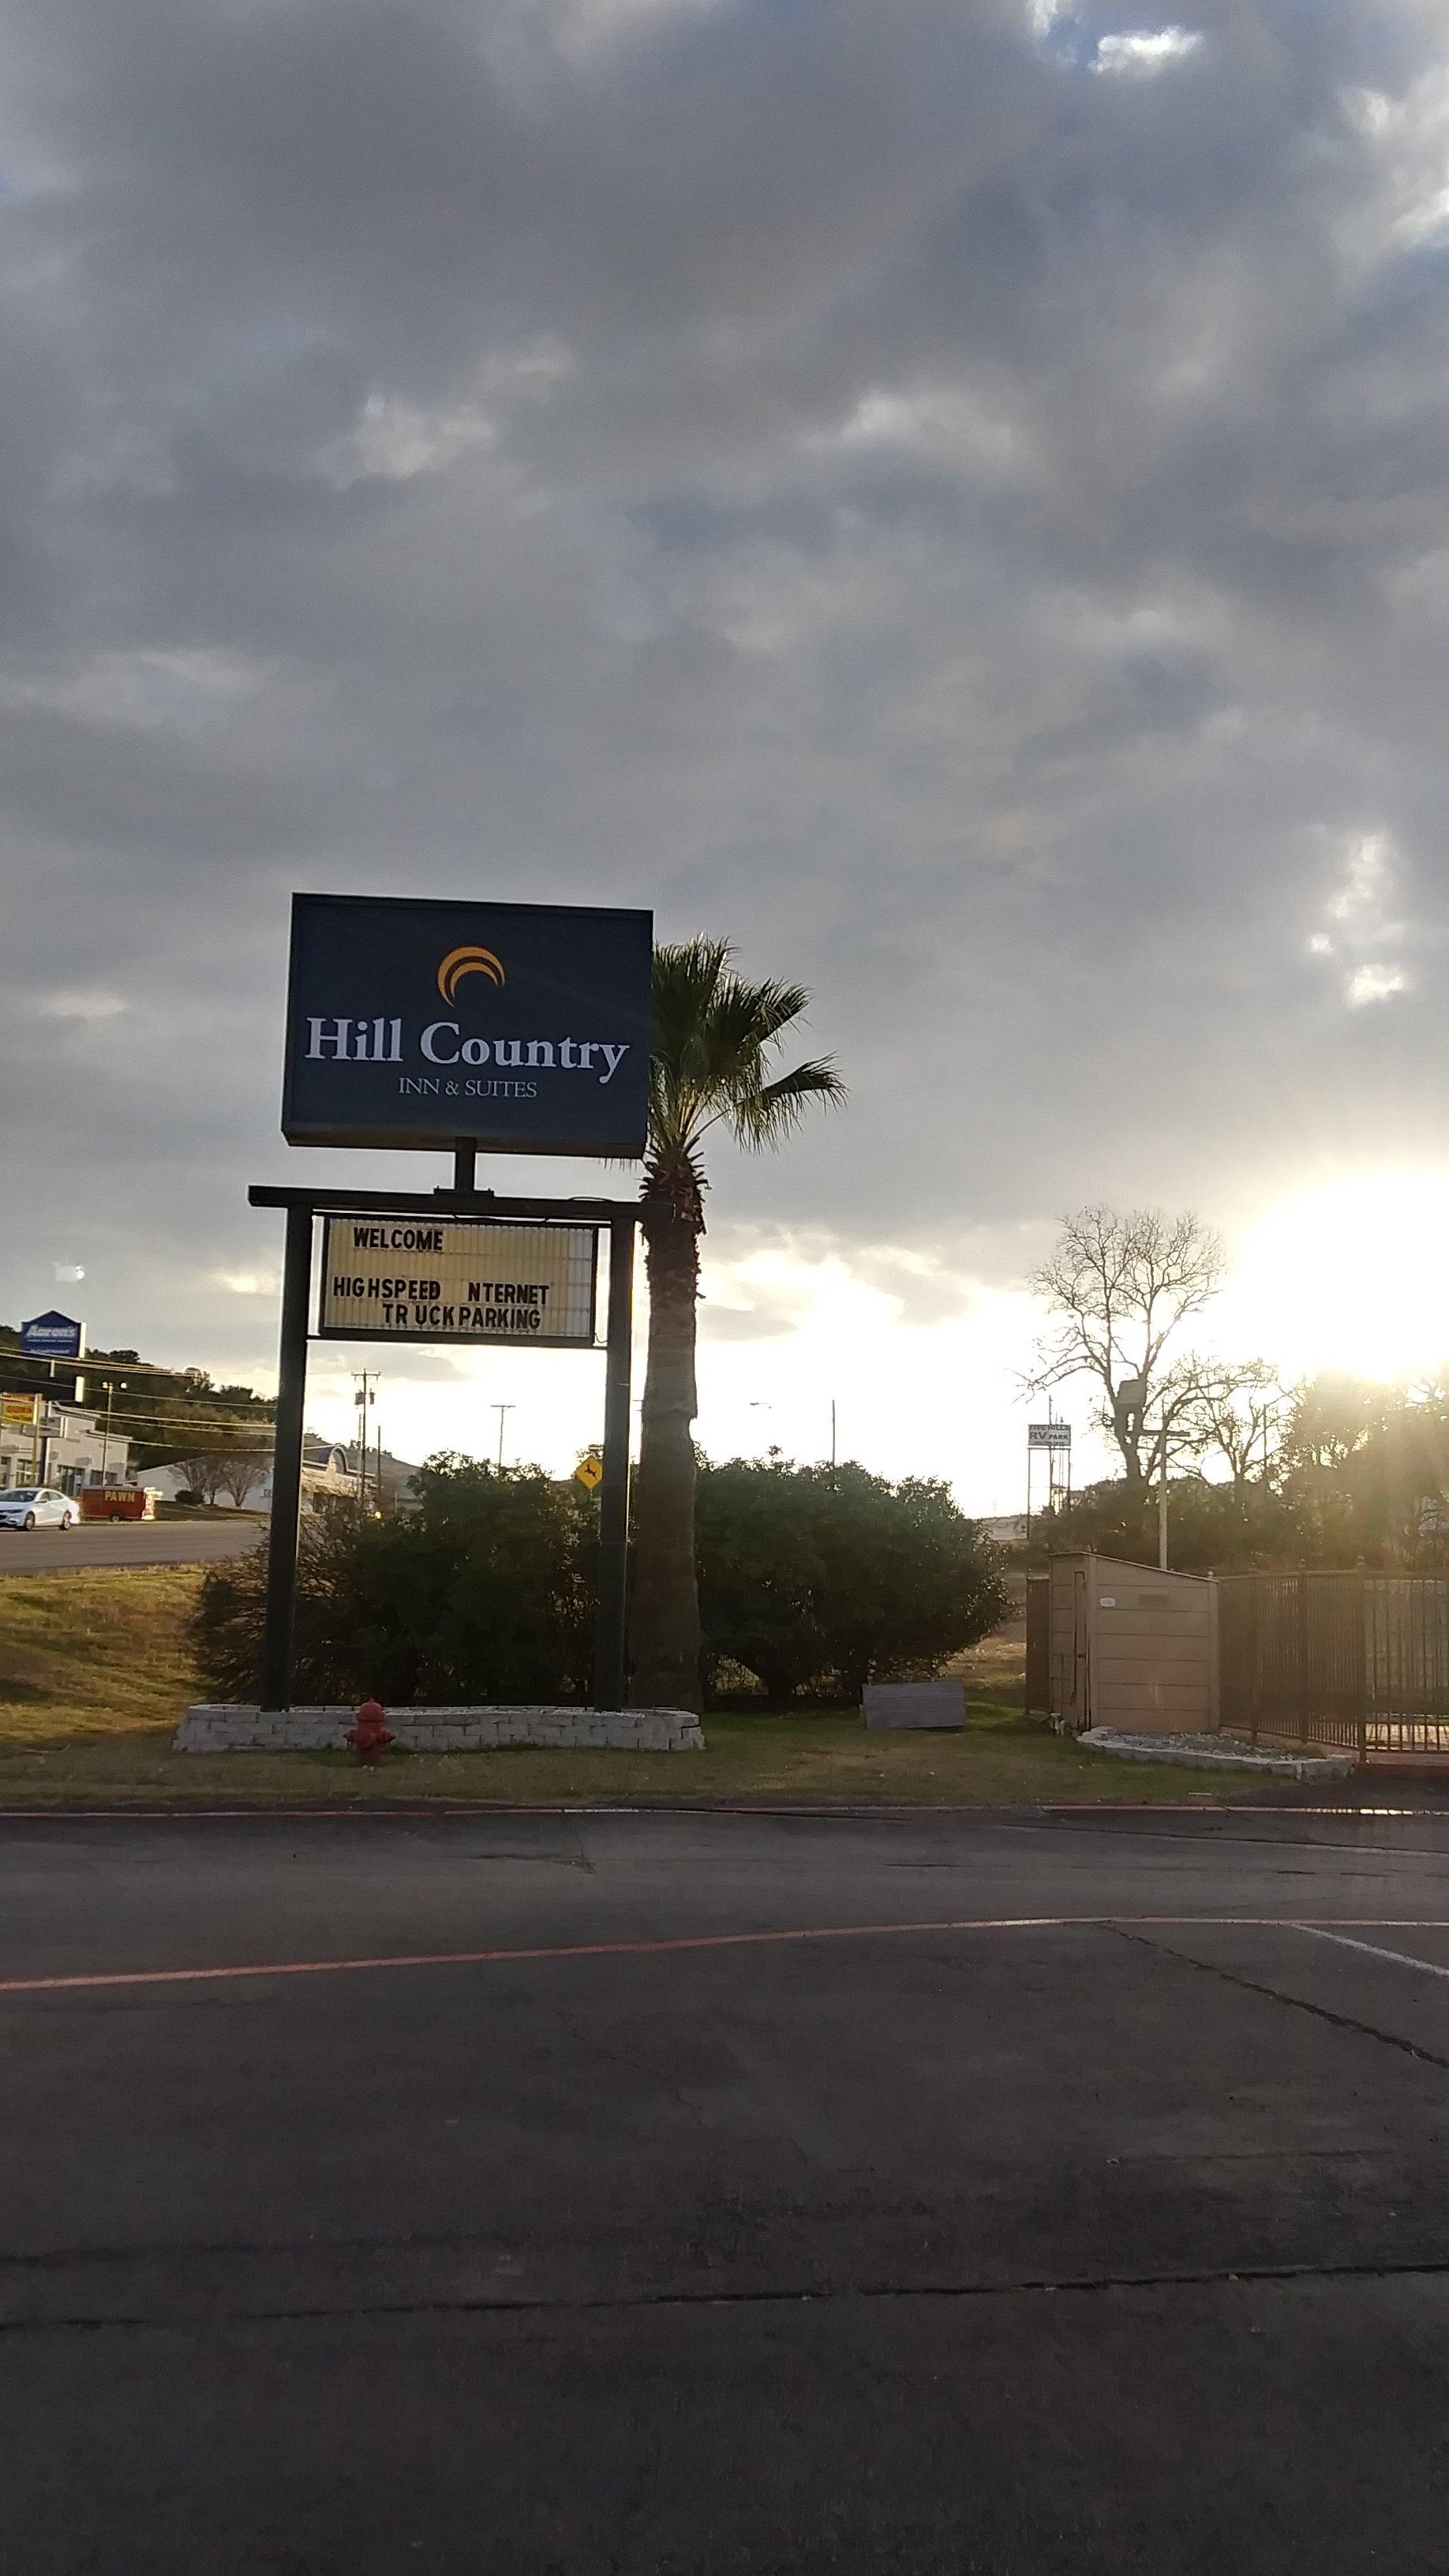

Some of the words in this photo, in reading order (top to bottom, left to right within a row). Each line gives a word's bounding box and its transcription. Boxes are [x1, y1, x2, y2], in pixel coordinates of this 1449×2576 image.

[305, 1017, 403, 1061] Hill
[420, 1022, 630, 1084] Country
[399, 1077, 440, 1095] INN
[445, 1080, 459, 1095] &
[465, 1079, 537, 1098] SUITES
[354, 1227, 444, 1251] WELCOME
[104, 1491, 135, 1503] PAWN
